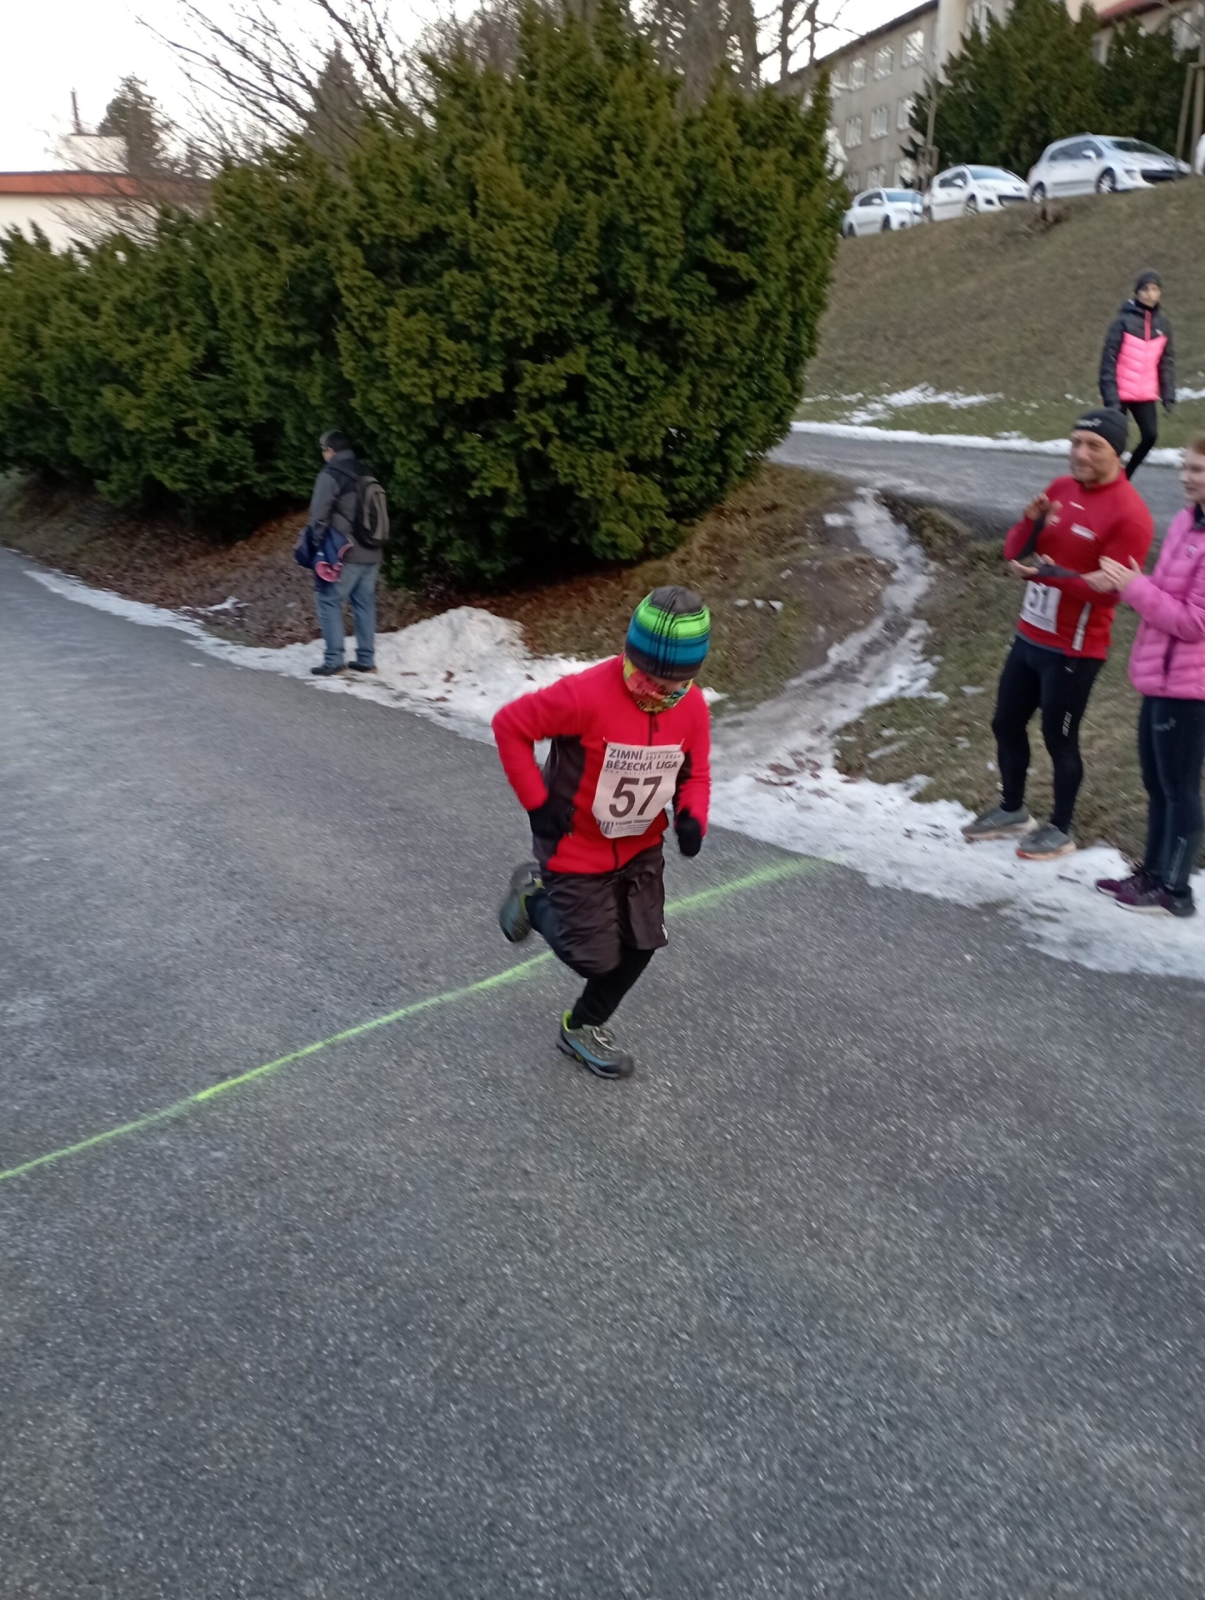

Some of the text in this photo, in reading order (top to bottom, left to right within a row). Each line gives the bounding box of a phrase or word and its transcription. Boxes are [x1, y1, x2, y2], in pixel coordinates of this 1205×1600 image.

[609, 748, 643, 760] ZIMNÍ
[606, 760, 677, 771] BĚŽECKÁ LIGA
[609, 776, 662, 818] 57
